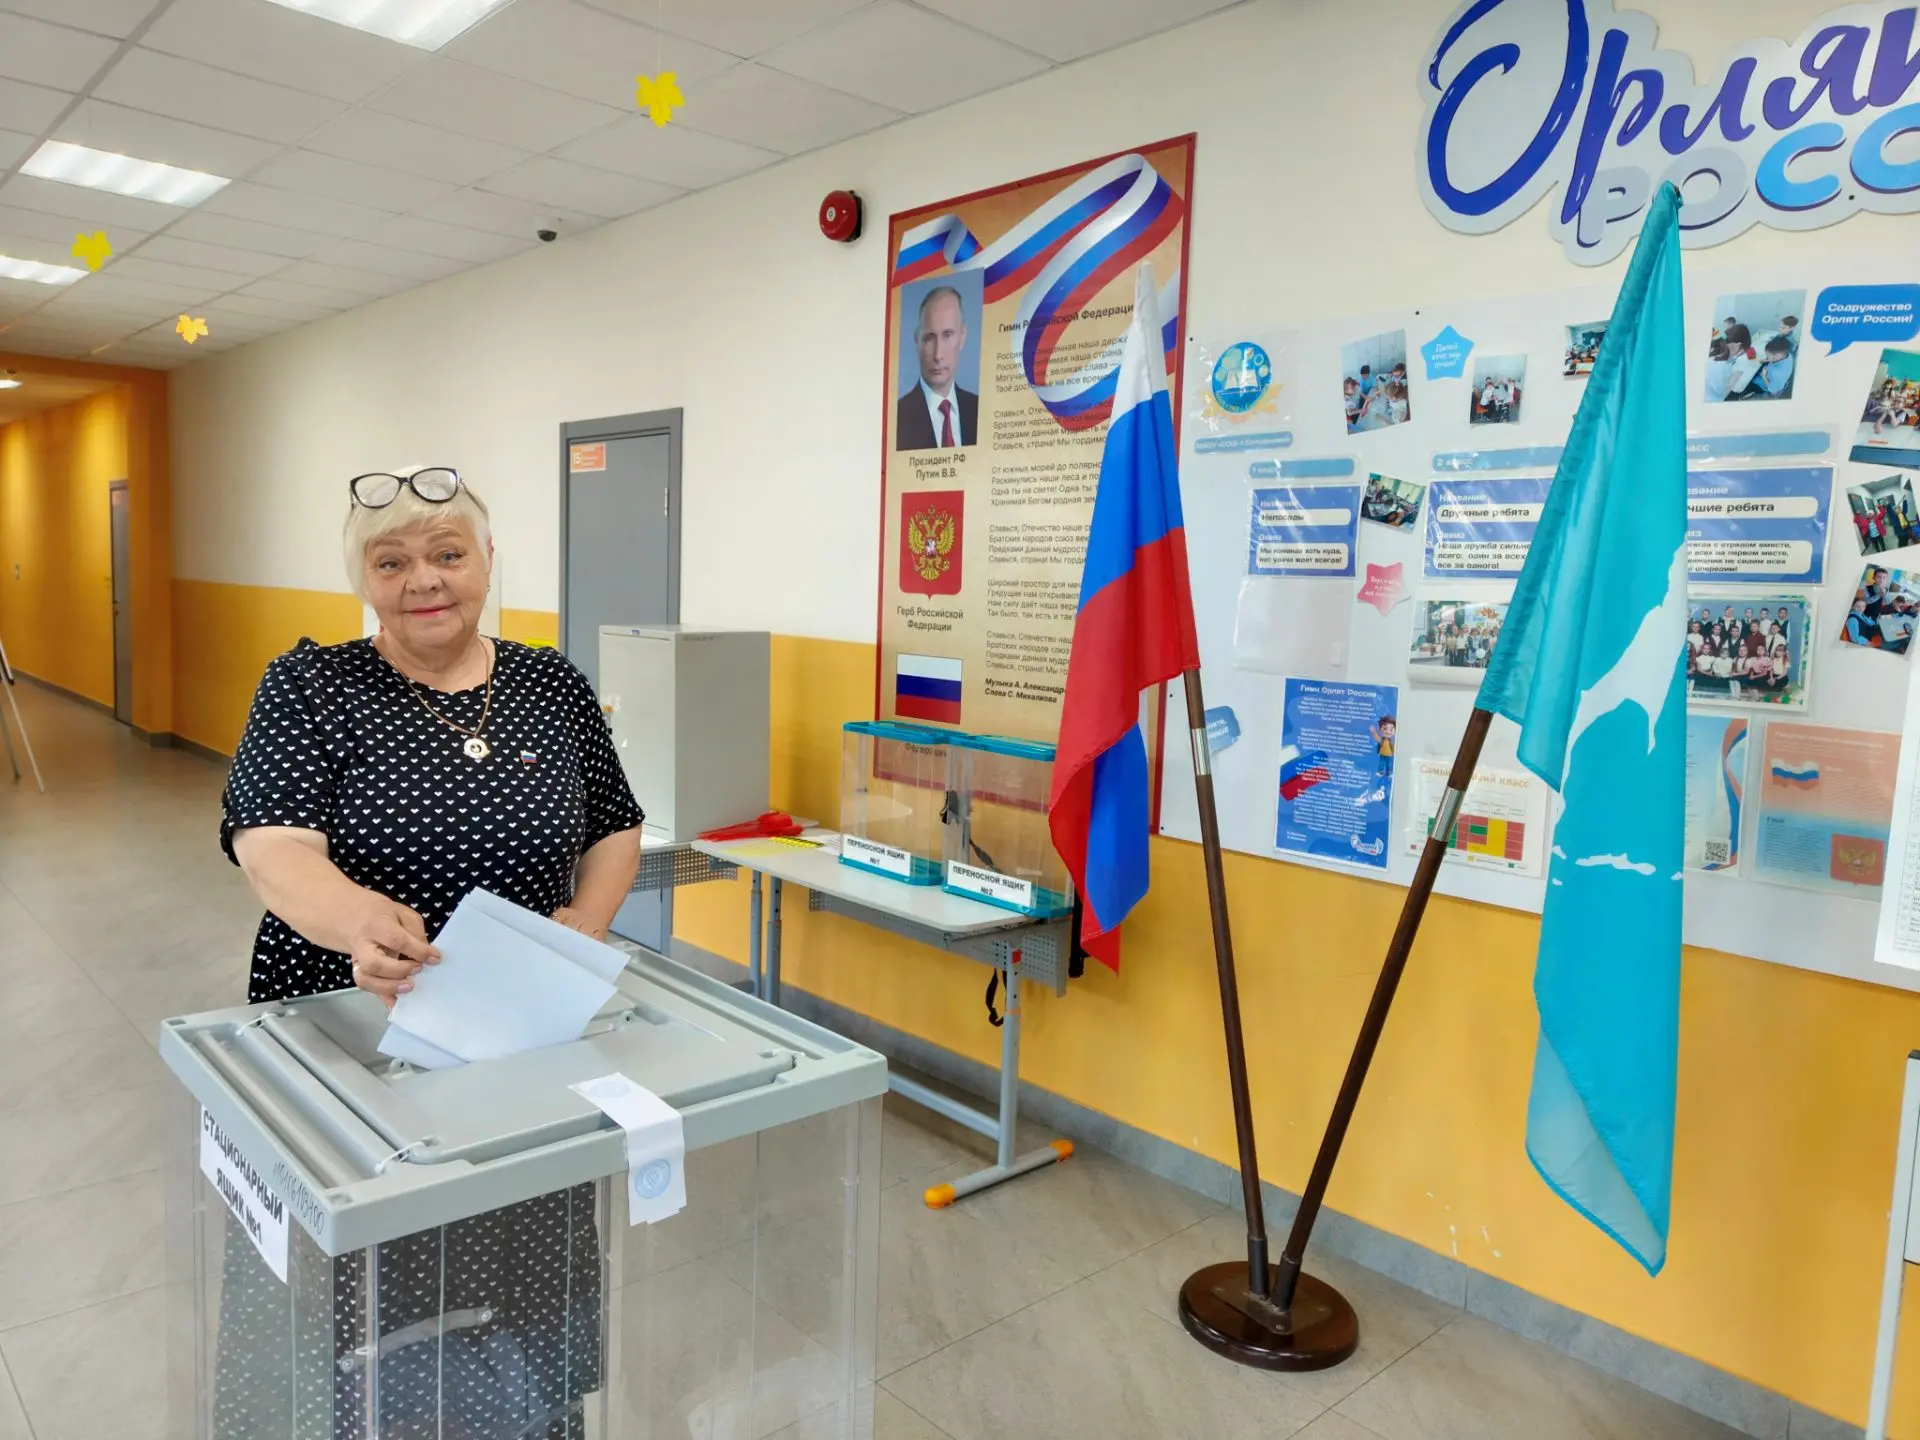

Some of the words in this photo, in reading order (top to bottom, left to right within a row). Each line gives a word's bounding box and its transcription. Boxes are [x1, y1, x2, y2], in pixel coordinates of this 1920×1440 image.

[1428, 0, 1920, 225] Орля
[1827, 303, 1912, 313] Содружество
[998, 322, 1021, 333] Гимн
[1081, 304, 1134, 321] Федераци
[1821, 314, 1860, 324] Орлят
[1863, 314, 1913, 323] России!
[993, 418, 1027, 429] Братских
[992, 431, 1030, 442] Предками
[1031, 428, 1059, 438] данная
[1057, 437, 1071, 446] Мы
[1687, 443, 1710, 452] асс
[909, 455, 951, 468] Президент
[953, 453, 966, 463] РФ
[991, 466, 1001, 474] От
[1030, 462, 1056, 472] морей
[1056, 463, 1067, 471] до
[1257, 466, 1280, 475] клас
[915, 469, 940, 481] Путин
[941, 468, 957, 478] В.В.
[991, 476, 1038, 486] Раскинулись
[1039, 475, 1060, 483] наши
[1061, 473, 1080, 481] леса
[991, 487, 1010, 496] Одна
[1011, 487, 1021, 495] ты
[1058, 484, 1079, 493] Одна
[990, 498, 1027, 507] Хранимая
[1027, 496, 1051, 505] Богом
[1053, 497, 1082, 505] родная
[1687, 502, 1723, 512] чшие
[1726, 502, 1775, 514] ребята
[1021, 524, 1061, 532] Отечество
[989, 535, 1020, 544] Братских
[1022, 535, 1053, 543] народов
[988, 545, 1024, 553] Предками
[1025, 546, 1051, 554] данная
[1052, 545, 1087, 555] мудрост
[1464, 542, 1497, 551] дружба
[1466, 561, 1499, 570] одного!
[1694, 565, 1738, 573] опередим!
[987, 579, 1019, 588] Широкий
[1003, 601, 1019, 609] силу
[896, 605, 914, 617] Герб
[916, 606, 964, 620] Российской
[987, 609, 999, 617] Так
[907, 619, 952, 632] Федерации
[986, 641, 1017, 650] Братских
[1019, 644, 1049, 653] народов
[985, 678, 1013, 688] Музыка
[1013, 681, 1022, 689] А.
[1022, 681, 1065, 694] Александр
[1300, 684, 1320, 694] Гимн
[984, 687, 1007, 697] Слова
[1016, 691, 1057, 703] Михалкова
[1420, 764, 1451, 777] Самы
[1499, 777, 1529, 789] класс
[846, 838, 886, 856] ПЕРЕНОСНОЙ
[886, 847, 906, 861] ЯЩИК
[952, 865, 1000, 886] ПЕРЕНОСНОЙ
[1001, 879, 1025, 892] ЯЩИК
[980, 886, 994, 896] №2
[203, 1109, 283, 1225] СТАЦИОНАРНЫЙ
[216, 1167, 245, 1220] ЯЩИК
[245, 1204, 263, 1246] №1
